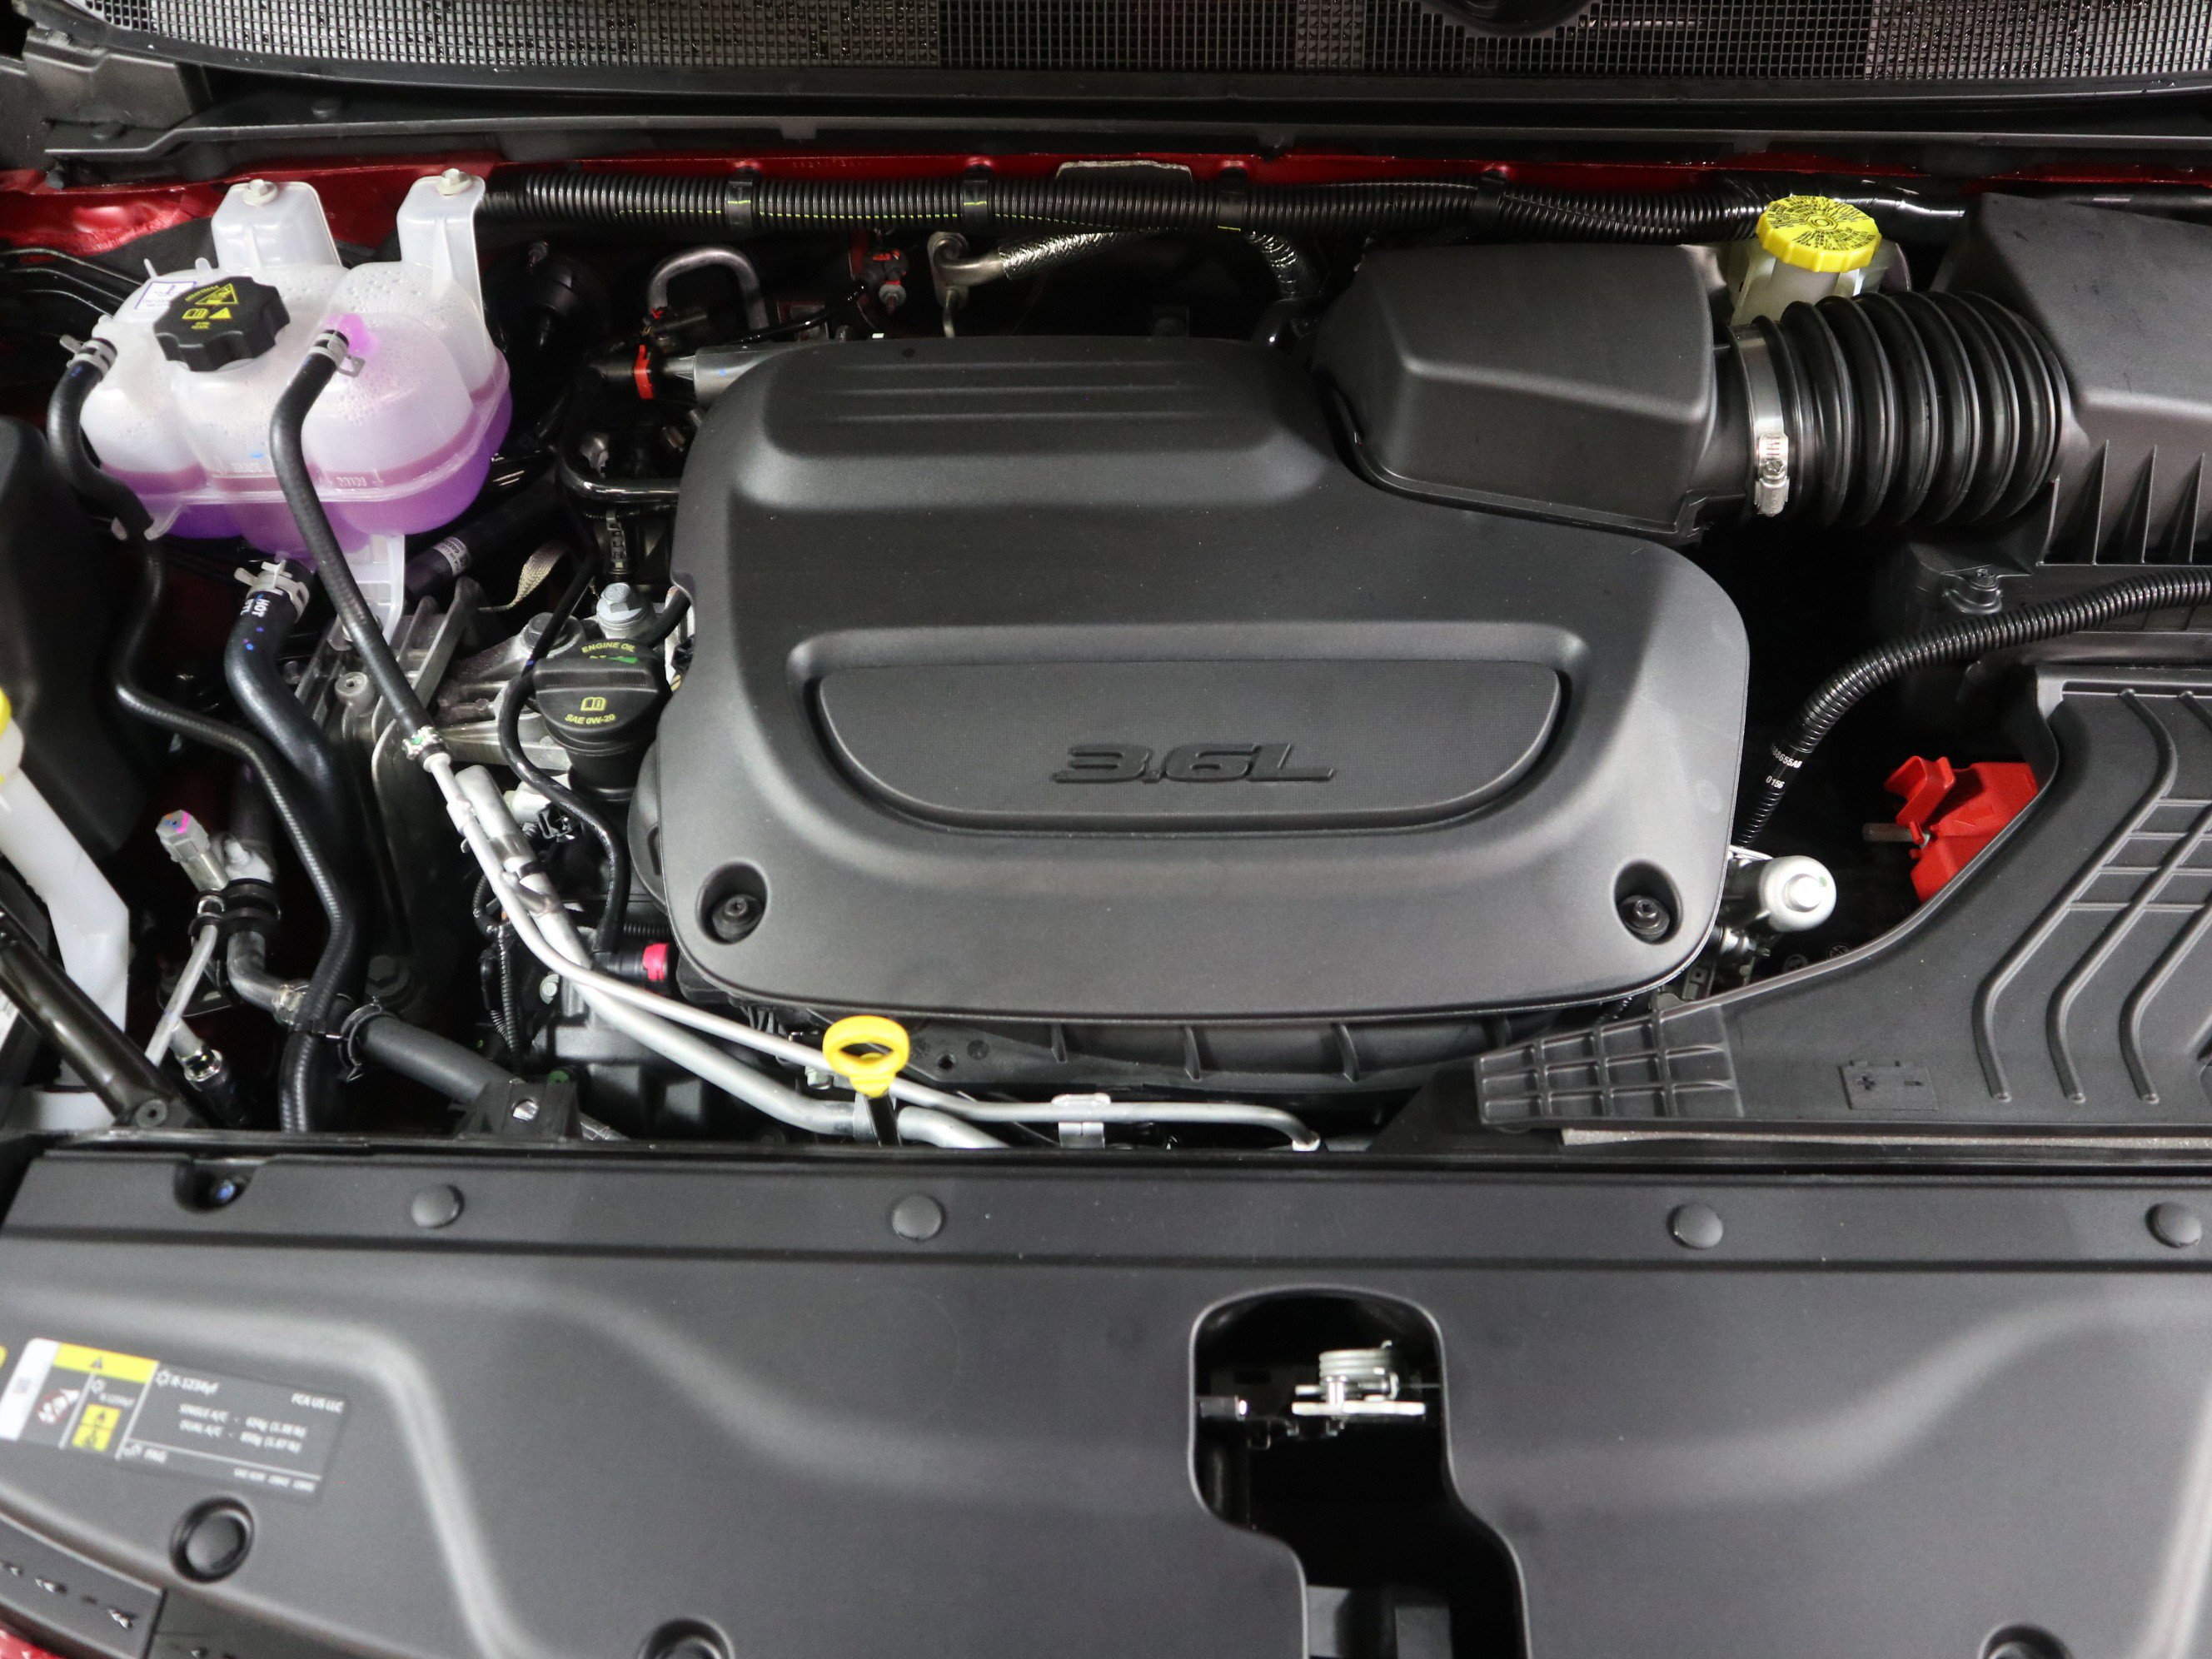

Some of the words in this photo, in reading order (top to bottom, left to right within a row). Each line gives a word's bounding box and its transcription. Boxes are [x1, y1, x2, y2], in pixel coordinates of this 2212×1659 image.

[252, 598, 271, 619] HOT
[581, 641, 619, 654] ENGINE
[620, 642, 635, 653] OIL
[565, 713, 585, 725] SAE
[585, 713, 616, 725] 0W-20
[1051, 743, 1336, 785] 3.6L
[1766, 775, 1785, 789] 0156
